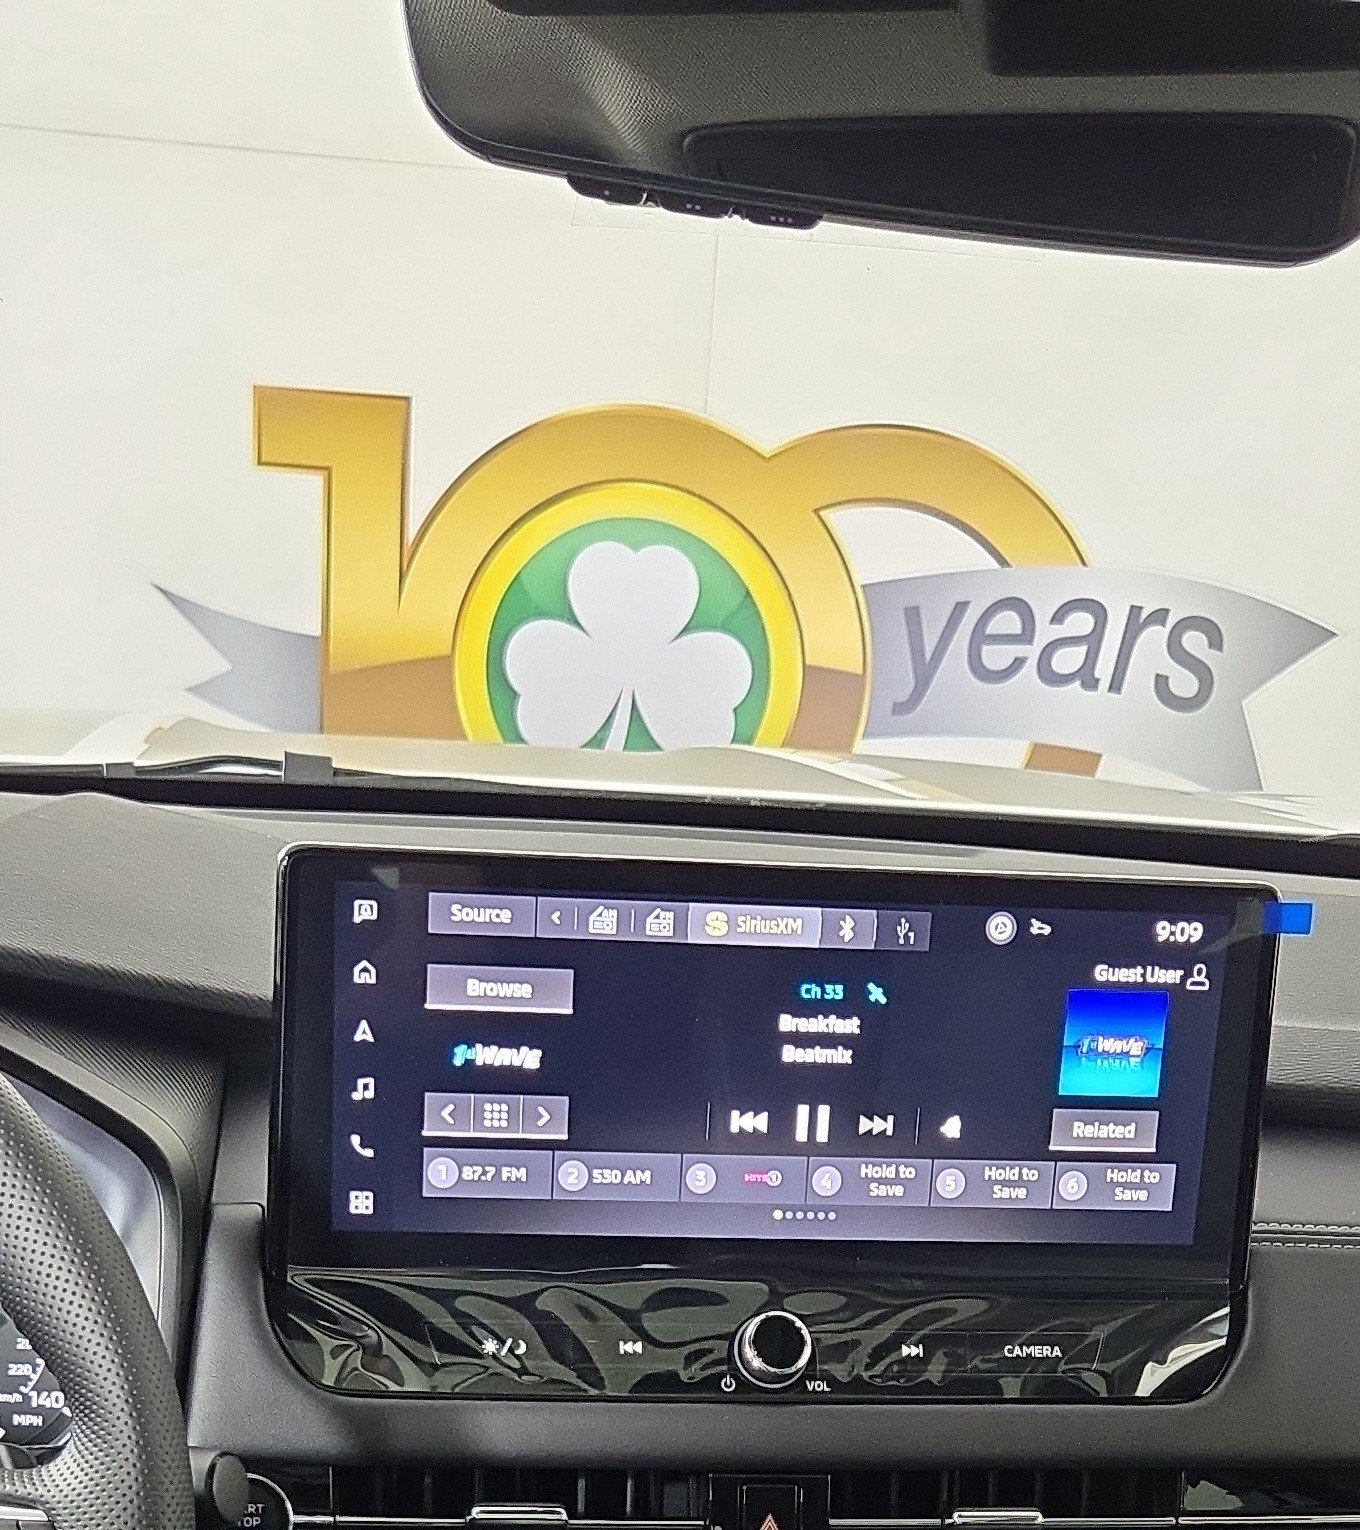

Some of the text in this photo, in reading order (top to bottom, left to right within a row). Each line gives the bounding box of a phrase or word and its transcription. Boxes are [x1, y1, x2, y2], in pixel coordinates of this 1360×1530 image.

[890, 595, 1225, 718] years
[450, 904, 512, 924] Source
[736, 915, 802, 935] SiriusXM
[1156, 920, 1204, 943] 9:09
[1094, 964, 1184, 984] Guest User
[466, 978, 533, 1000] Browse
[800, 983, 844, 1000] Ch 33
[779, 1014, 861, 1035] Breakfast
[782, 1044, 853, 1065] Beatmix
[1072, 1121, 1136, 1140] Related
[461, 1165, 496, 1182] 87.7
[501, 1167, 528, 1183] FM
[567, 1168, 652, 1186] 2 530 AM
[695, 1170, 707, 1187] 3
[821, 1163, 916, 1189] 4 Hold to
[944, 1166, 1039, 1192] 5 Hold to
[1067, 1168, 1160, 1194] 6 Hold to
[869, 1181, 904, 1198] Save
[992, 1184, 1027, 1200] Save
[1114, 1186, 1149, 1202] Save
[1003, 1344, 1063, 1359] CAMERA
[7, 1364, 33, 1376] 220
[805, 1380, 832, 1392] VOL
[28, 1391, 65, 1408] 140
[12, 1414, 44, 1428] MPH
